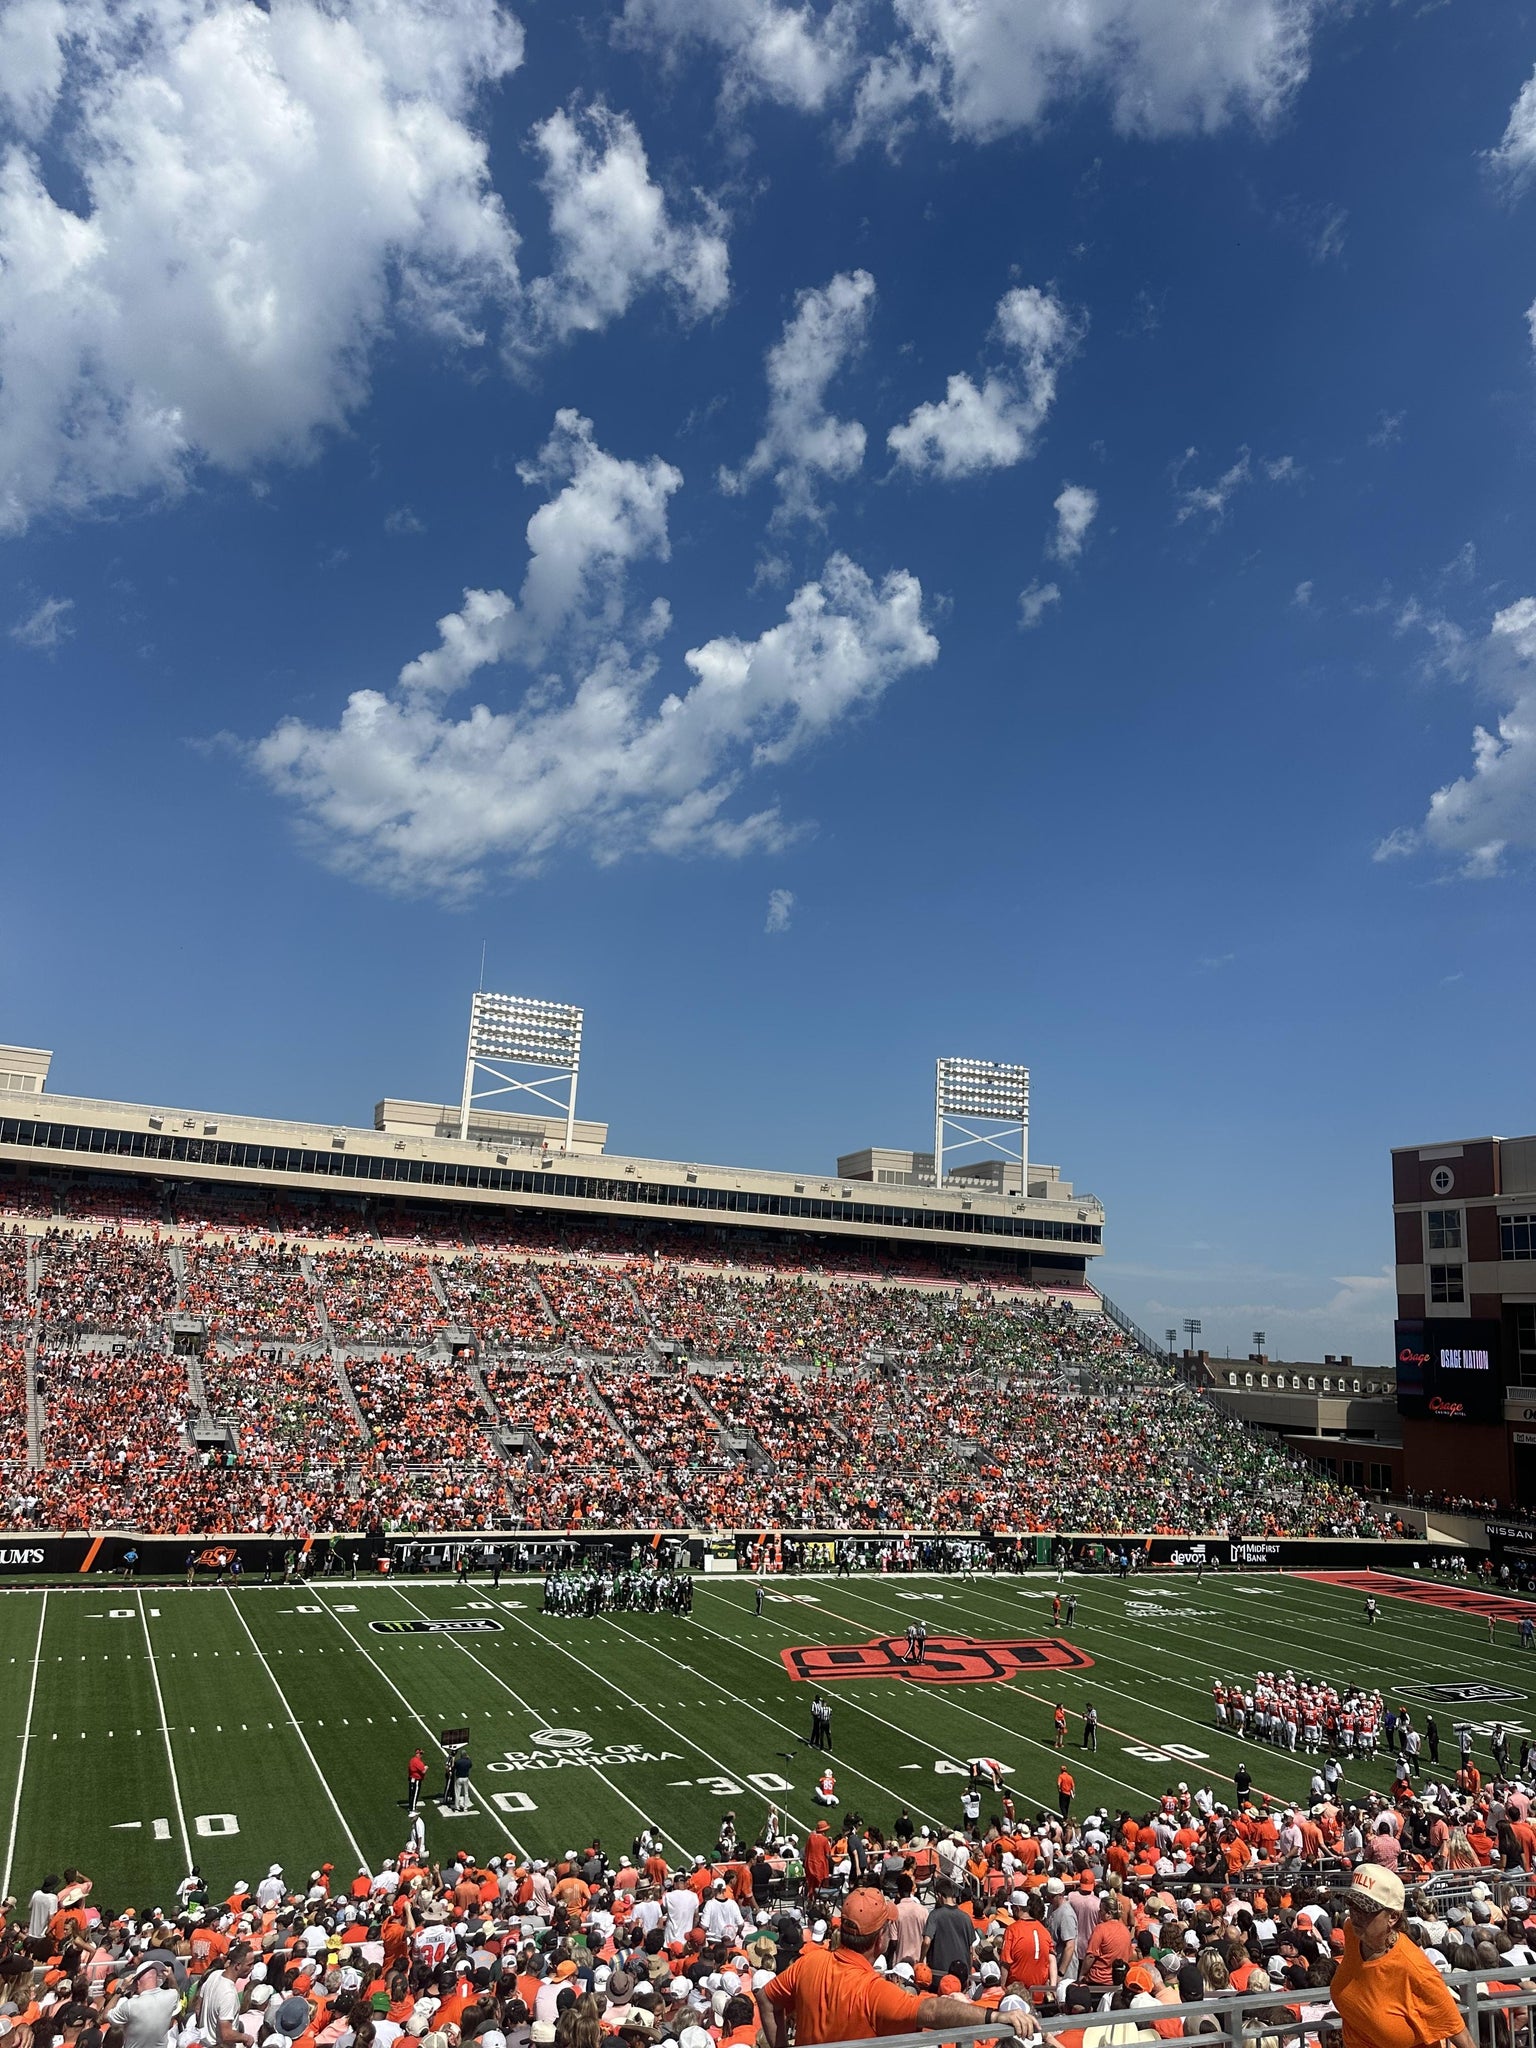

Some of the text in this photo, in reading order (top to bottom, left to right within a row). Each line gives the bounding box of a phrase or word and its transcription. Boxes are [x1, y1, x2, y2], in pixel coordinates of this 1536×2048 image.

[1400, 1348, 1430, 1366] Osage
[1440, 1349, 1488, 1369] OSAGE NATION
[1429, 1396, 1463, 1416] Osage
[1487, 1525, 1533, 1540] NISSAN
[1170, 1550, 1206, 1565] devon
[486, 1750, 685, 1772] OKLAHOMA
[504, 1744, 644, 1762] BANK OF
[1121, 1744, 1210, 1762] 50
[697, 1772, 795, 1796] 30
[823, 1779, 833, 1790] 85
[151, 1813, 240, 1840] 10
[426, 1935, 444, 1943] THOMAS
[1033, 1929, 1040, 1960] 1
[420, 1943, 446, 1968] 34
